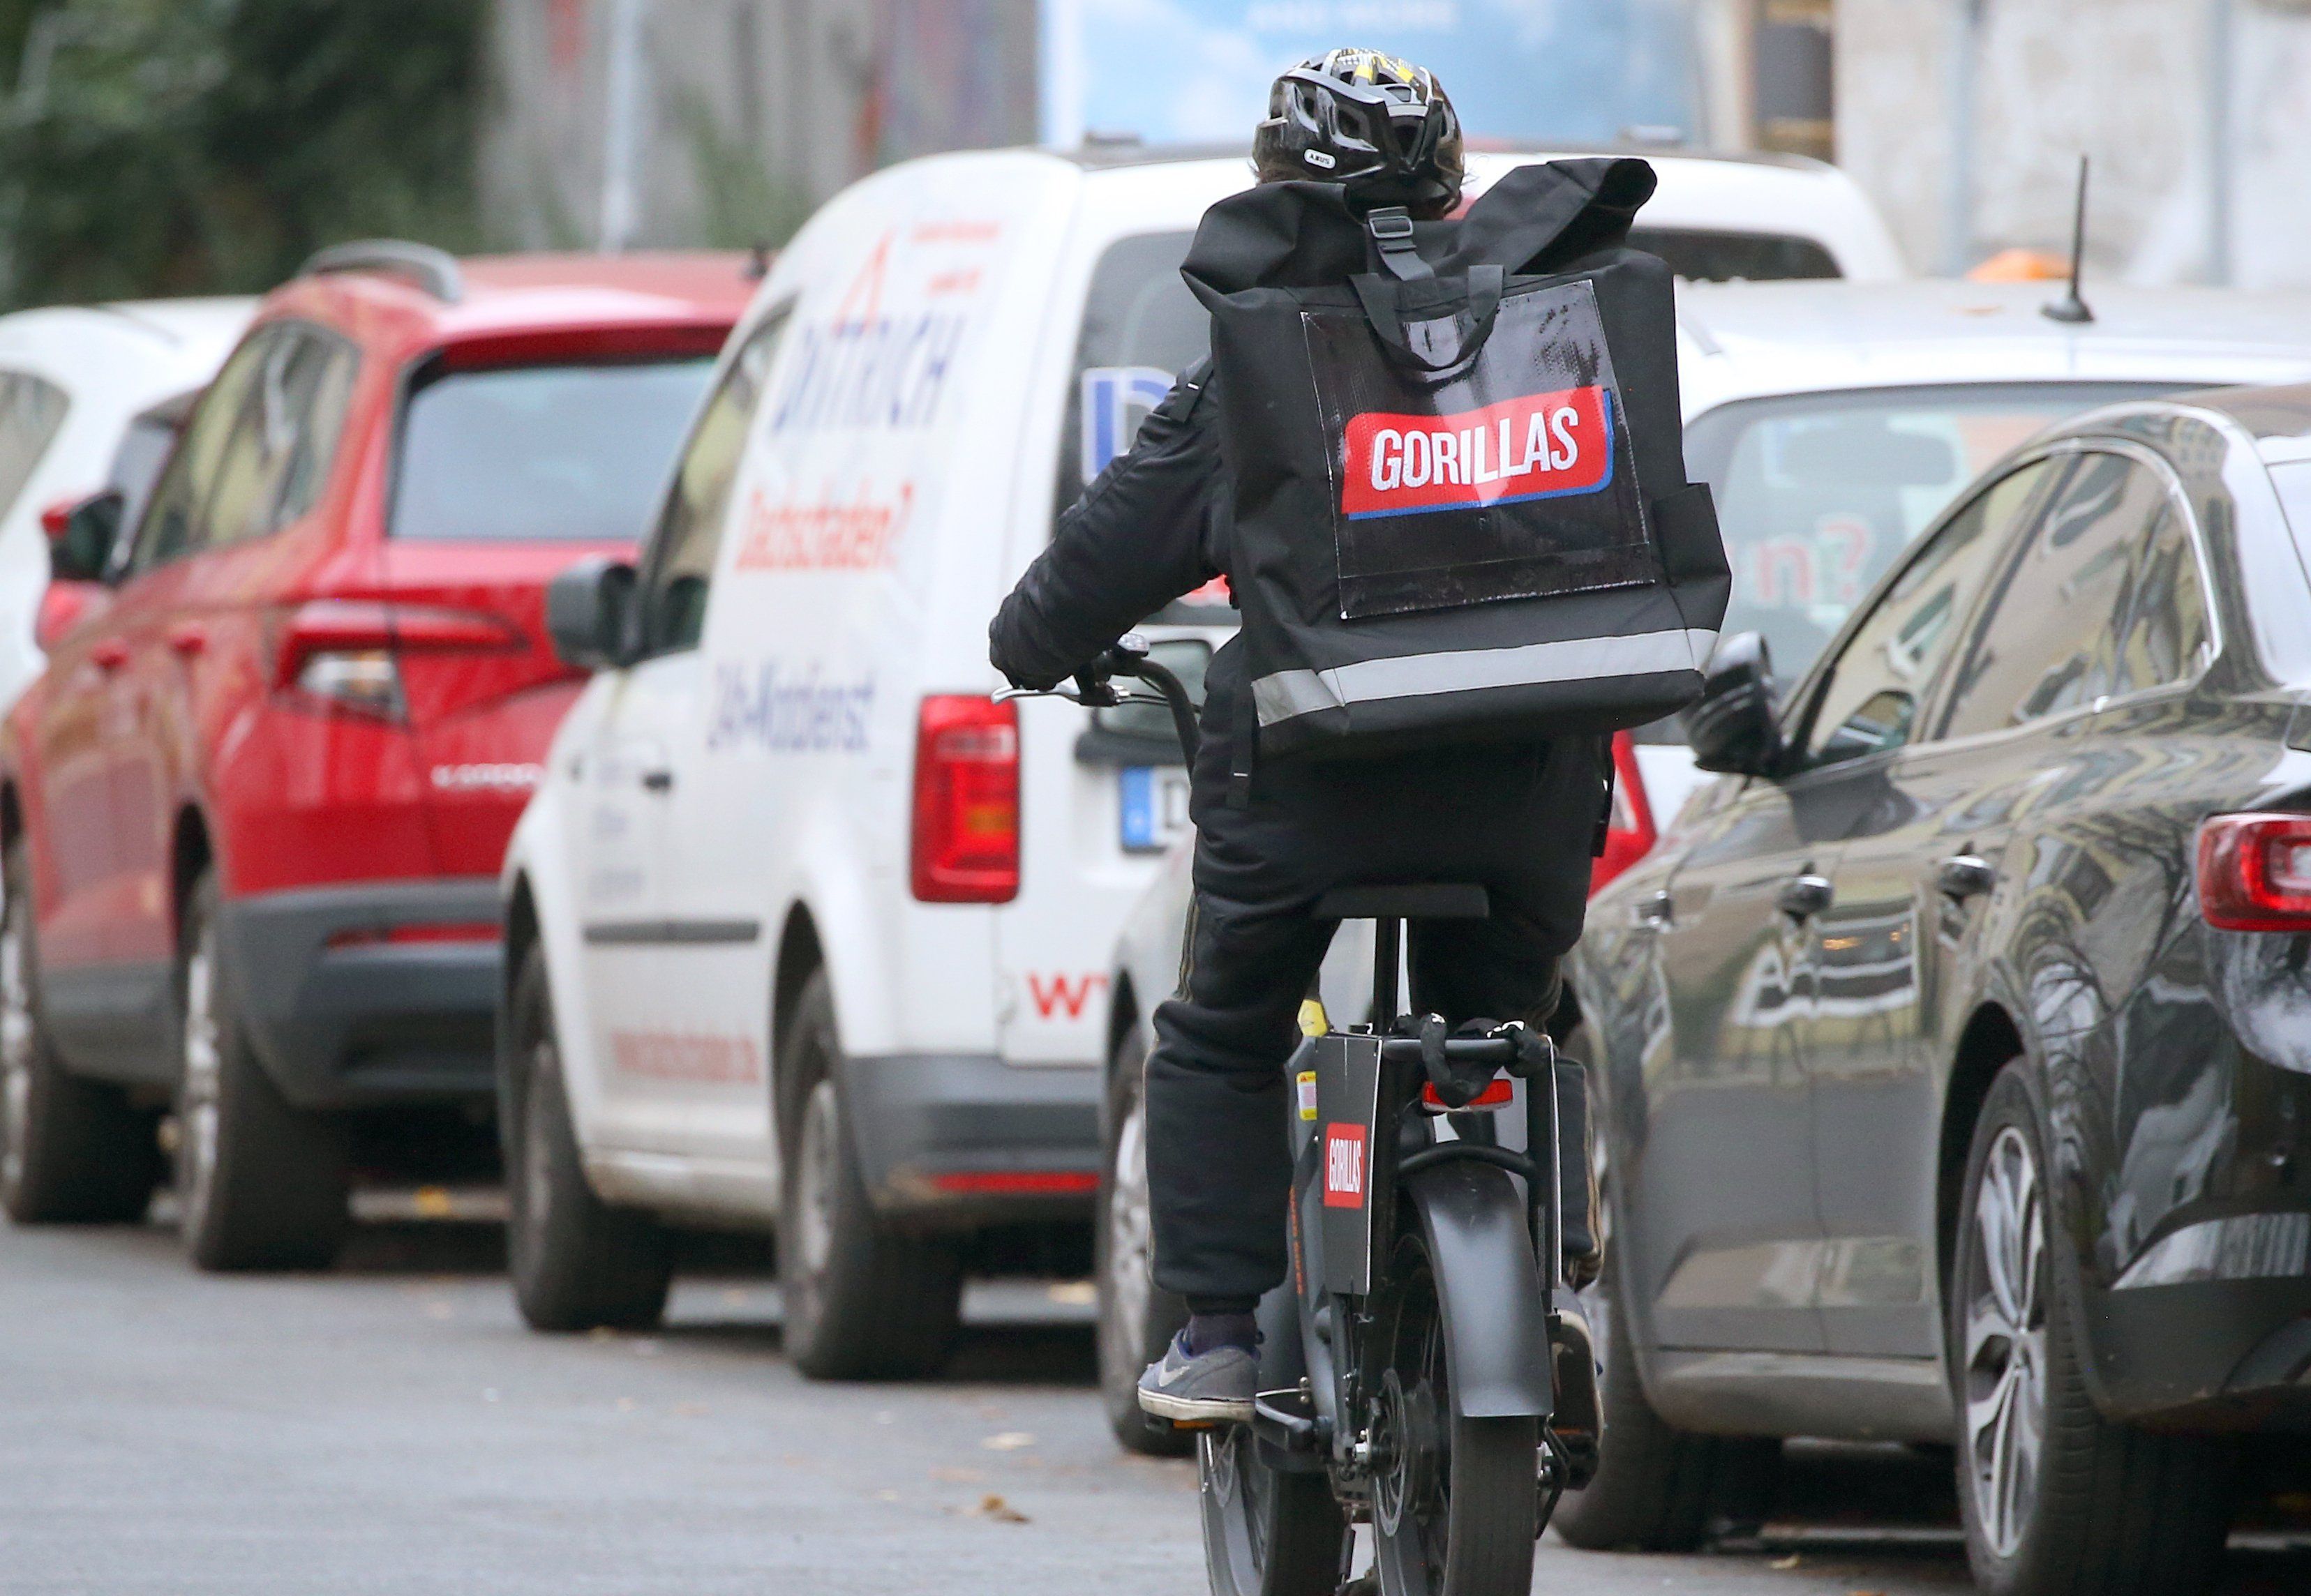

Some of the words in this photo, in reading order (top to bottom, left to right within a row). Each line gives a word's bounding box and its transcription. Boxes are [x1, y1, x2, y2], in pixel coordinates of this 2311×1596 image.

[1308, 153, 1330, 165] ABUS
[1370, 407, 1579, 492] GORILLAS
[1027, 970, 1111, 1020] w
[1329, 1138, 1361, 1194] GORILLAS
